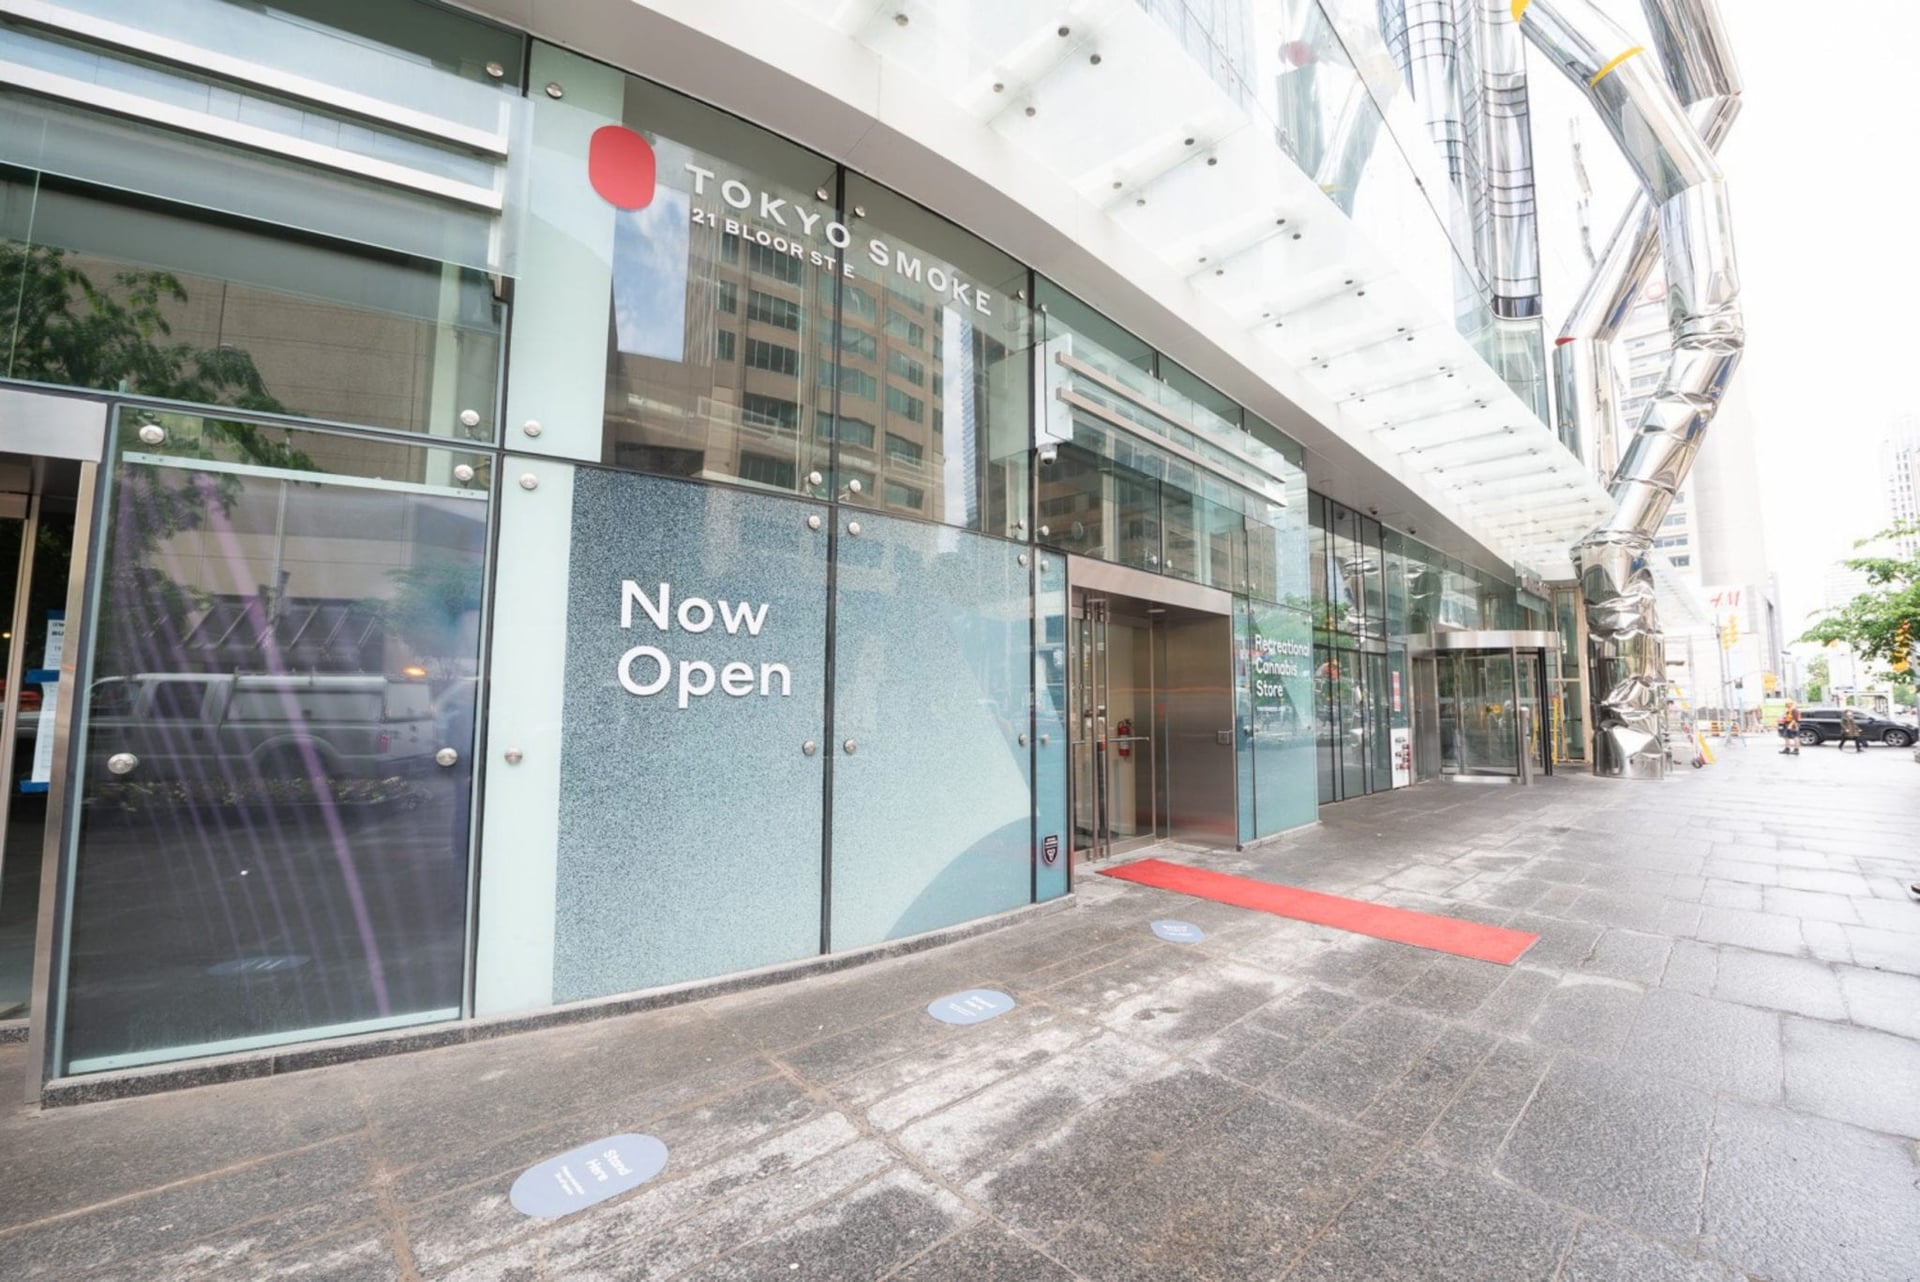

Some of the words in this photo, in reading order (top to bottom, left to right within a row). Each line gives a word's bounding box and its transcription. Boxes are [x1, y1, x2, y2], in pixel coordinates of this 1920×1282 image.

[684, 163, 851, 249] TOKYO
[868, 238, 992, 317] SMOKE
[691, 207, 716, 229] 21
[725, 217, 804, 260] BLOOR
[810, 250, 837, 271] ST
[843, 263, 856, 280] E
[620, 579, 770, 636] Now
[1710, 590, 1741, 608] HM
[1255, 633, 1310, 657] Recreational
[617, 645, 792, 709] Open
[1256, 656, 1298, 677] Cannabis
[1256, 679, 1284, 697] Store
